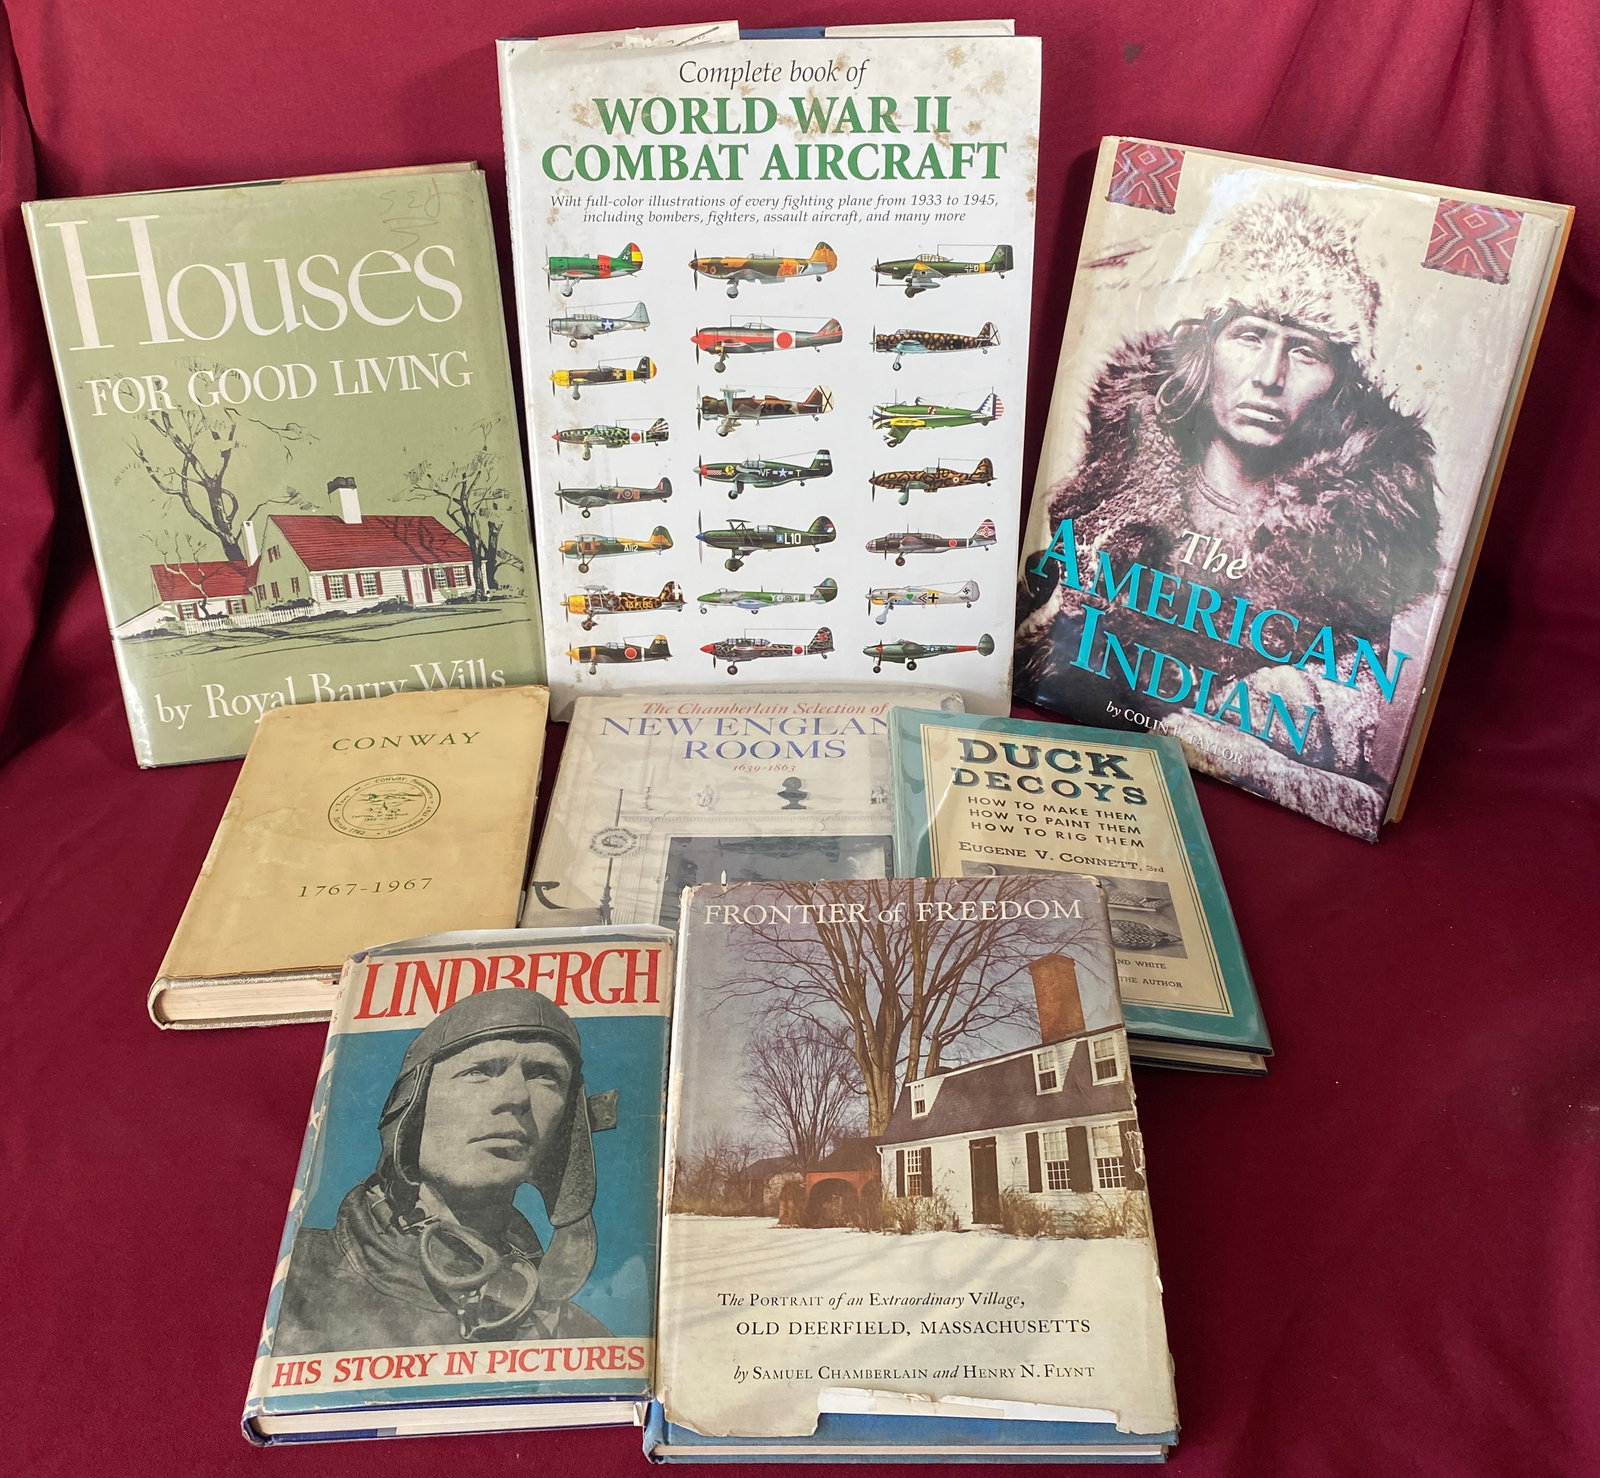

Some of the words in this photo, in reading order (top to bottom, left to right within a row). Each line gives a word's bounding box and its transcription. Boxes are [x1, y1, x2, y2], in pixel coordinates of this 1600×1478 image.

[678, 60, 782, 90] Complete
[790, 60, 839, 84] book
[844, 59, 870, 89] of
[594, 97, 778, 135] WORLD
[788, 95, 903, 135] WAR
[913, 95, 952, 133] II
[541, 144, 749, 182] COMBAT
[762, 142, 1008, 180] AIRCRAFT
[550, 195, 582, 208] Wiht
[585, 195, 644, 208] full-color
[648, 195, 725, 207] illustrations
[729, 195, 742, 210] of
[745, 198, 779, 211] every
[782, 195, 835, 211] fighting
[838, 195, 872, 211] plane
[875, 195, 907, 210] from
[910, 195, 942, 207] 1933
[946, 196, 958, 207] to
[963, 195, 999, 208] 1945,
[583, 211, 644, 225] including
[648, 211, 704, 224] bombers,
[707, 211, 760, 225] fighters,
[763, 211, 808, 223] assault
[811, 211, 862, 225] aircraft,
[866, 211, 890, 223] and
[894, 213, 930, 225] many
[934, 213, 966, 223] more
[45, 214, 464, 352] Houses
[85, 375, 176, 417] FOR
[188, 363, 317, 409] GOOD
[331, 350, 473, 398] LIVING
[784, 532, 801, 545] L10
[1178, 529, 1249, 580] The
[1030, 518, 1412, 703] AMERICAN
[1069, 603, 1320, 755] INDIAN
[155, 694, 192, 730] by
[201, 676, 296, 723] Royal
[308, 673, 408, 702] Barry
[410, 658, 505, 690] Wills
[642, 703, 675, 714] The
[677, 703, 789, 714] Chamberlain
[793, 703, 867, 714] Selection
[870, 703, 889, 717] of
[601, 717, 703, 736] NEW
[714, 717, 888, 736] ENGLAN
[1106, 701, 1121, 717] by
[1124, 708, 1169, 734] COLIN
[1188, 734, 1243, 765] TAYLOR
[331, 731, 480, 751] CONWAY
[683, 739, 847, 759] ROOMS
[732, 765, 796, 773] 1639-1863
[957, 738, 1134, 781] DUCK
[950, 767, 1149, 807] DECOYS
[968, 796, 1007, 808] HOW
[1014, 801, 1035, 811] TO
[1043, 804, 1088, 817] MAKE
[1096, 809, 1138, 822] THEM
[969, 808, 1008, 820] HOW
[1016, 813, 1037, 823] TO
[1045, 817, 1091, 829] PAINT
[1098, 822, 1142, 836] THEM
[971, 821, 1014, 834] HOW
[1024, 827, 1046, 838] TO
[1056, 831, 1087, 843] RIG
[1096, 835, 1145, 848] THEM
[958, 841, 1027, 858] EUGENE
[1035, 849, 1053, 861] V.
[1059, 852, 1142, 872] CONNETT,
[1146, 865, 1165, 873] 3rd
[297, 877, 432, 898] 1767-1967
[703, 903, 869, 925] FRONTIER
[878, 902, 906, 924] of
[917, 900, 1082, 923] FREEDOM
[1135, 961, 1167, 969] WHITE
[1143, 979, 1183, 988] AUTHOR
[718, 1293, 745, 1307] The
[750, 1293, 824, 1307] PORTRAIT
[828, 1292, 847, 1310] of
[849, 1296, 864, 1306] an
[869, 1292, 965, 1310] Extraordinary
[969, 1292, 1025, 1309] Village,
[736, 1321, 780, 1335] OLD
[789, 1320, 910, 1337] DEERFIELD,
[920, 1319, 1091, 1335] MASSACHUSETTS
[272, 1359, 322, 1388] HIS
[333, 1352, 440, 1384] STORY
[443, 1351, 478, 1377] IN
[485, 1344, 646, 1375] PICTURES
[733, 1366, 748, 1383] by
[753, 1366, 813, 1380] SAMUEL
[818, 1365, 928, 1380] CHAMBERLAIN
[933, 1365, 959, 1380] and
[963, 1365, 1016, 1379] HENRY
[1020, 1364, 1040, 1378] N.
[1044, 1364, 1095, 1378] FLYNT
